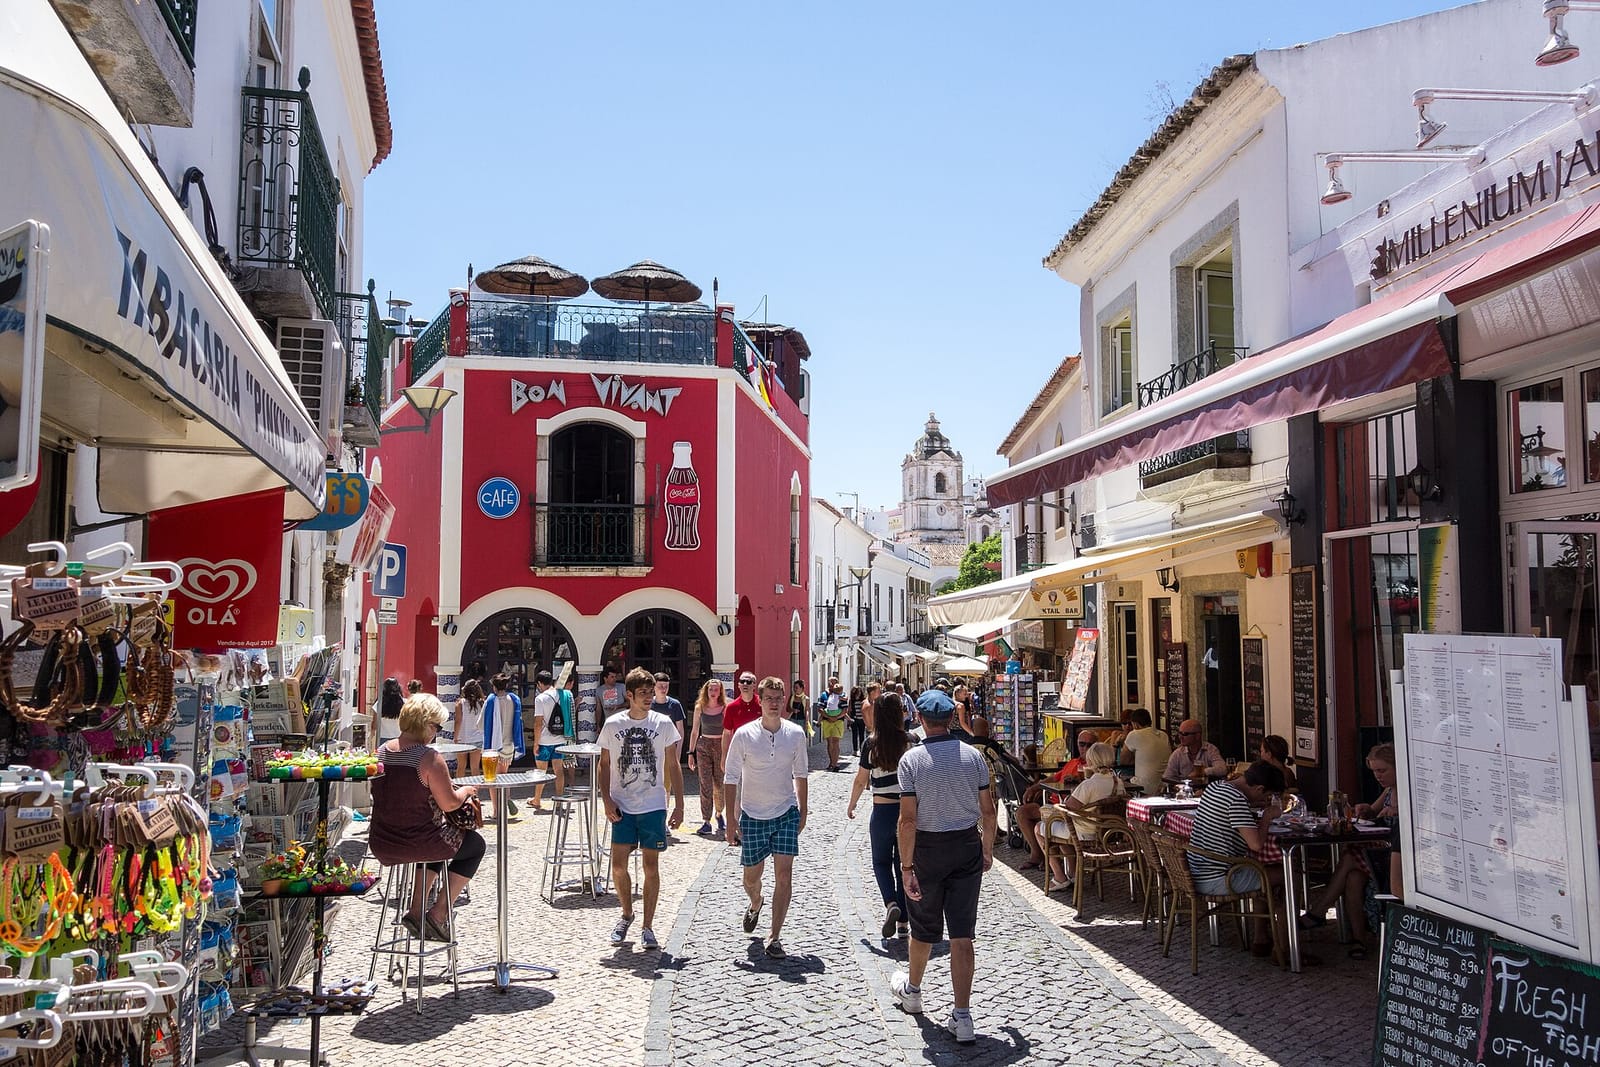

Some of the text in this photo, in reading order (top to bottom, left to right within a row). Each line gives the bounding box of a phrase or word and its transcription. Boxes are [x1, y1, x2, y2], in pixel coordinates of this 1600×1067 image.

[1388, 129, 1600, 274] MILLENIUM JA
[114, 224, 240, 418] TABACARIA
[670, 487, 696, 498] Coca-Cola
[380, 549, 400, 590] P
[27, 590, 77, 608] LEATHER
[28, 600, 78, 616] COLLECTION
[14, 821, 62, 840] LEATHER
[14, 832, 62, 850] COLLECTION
[1492, 955, 1586, 1029] FRESH
[1542, 1022, 1600, 1062] FISH
